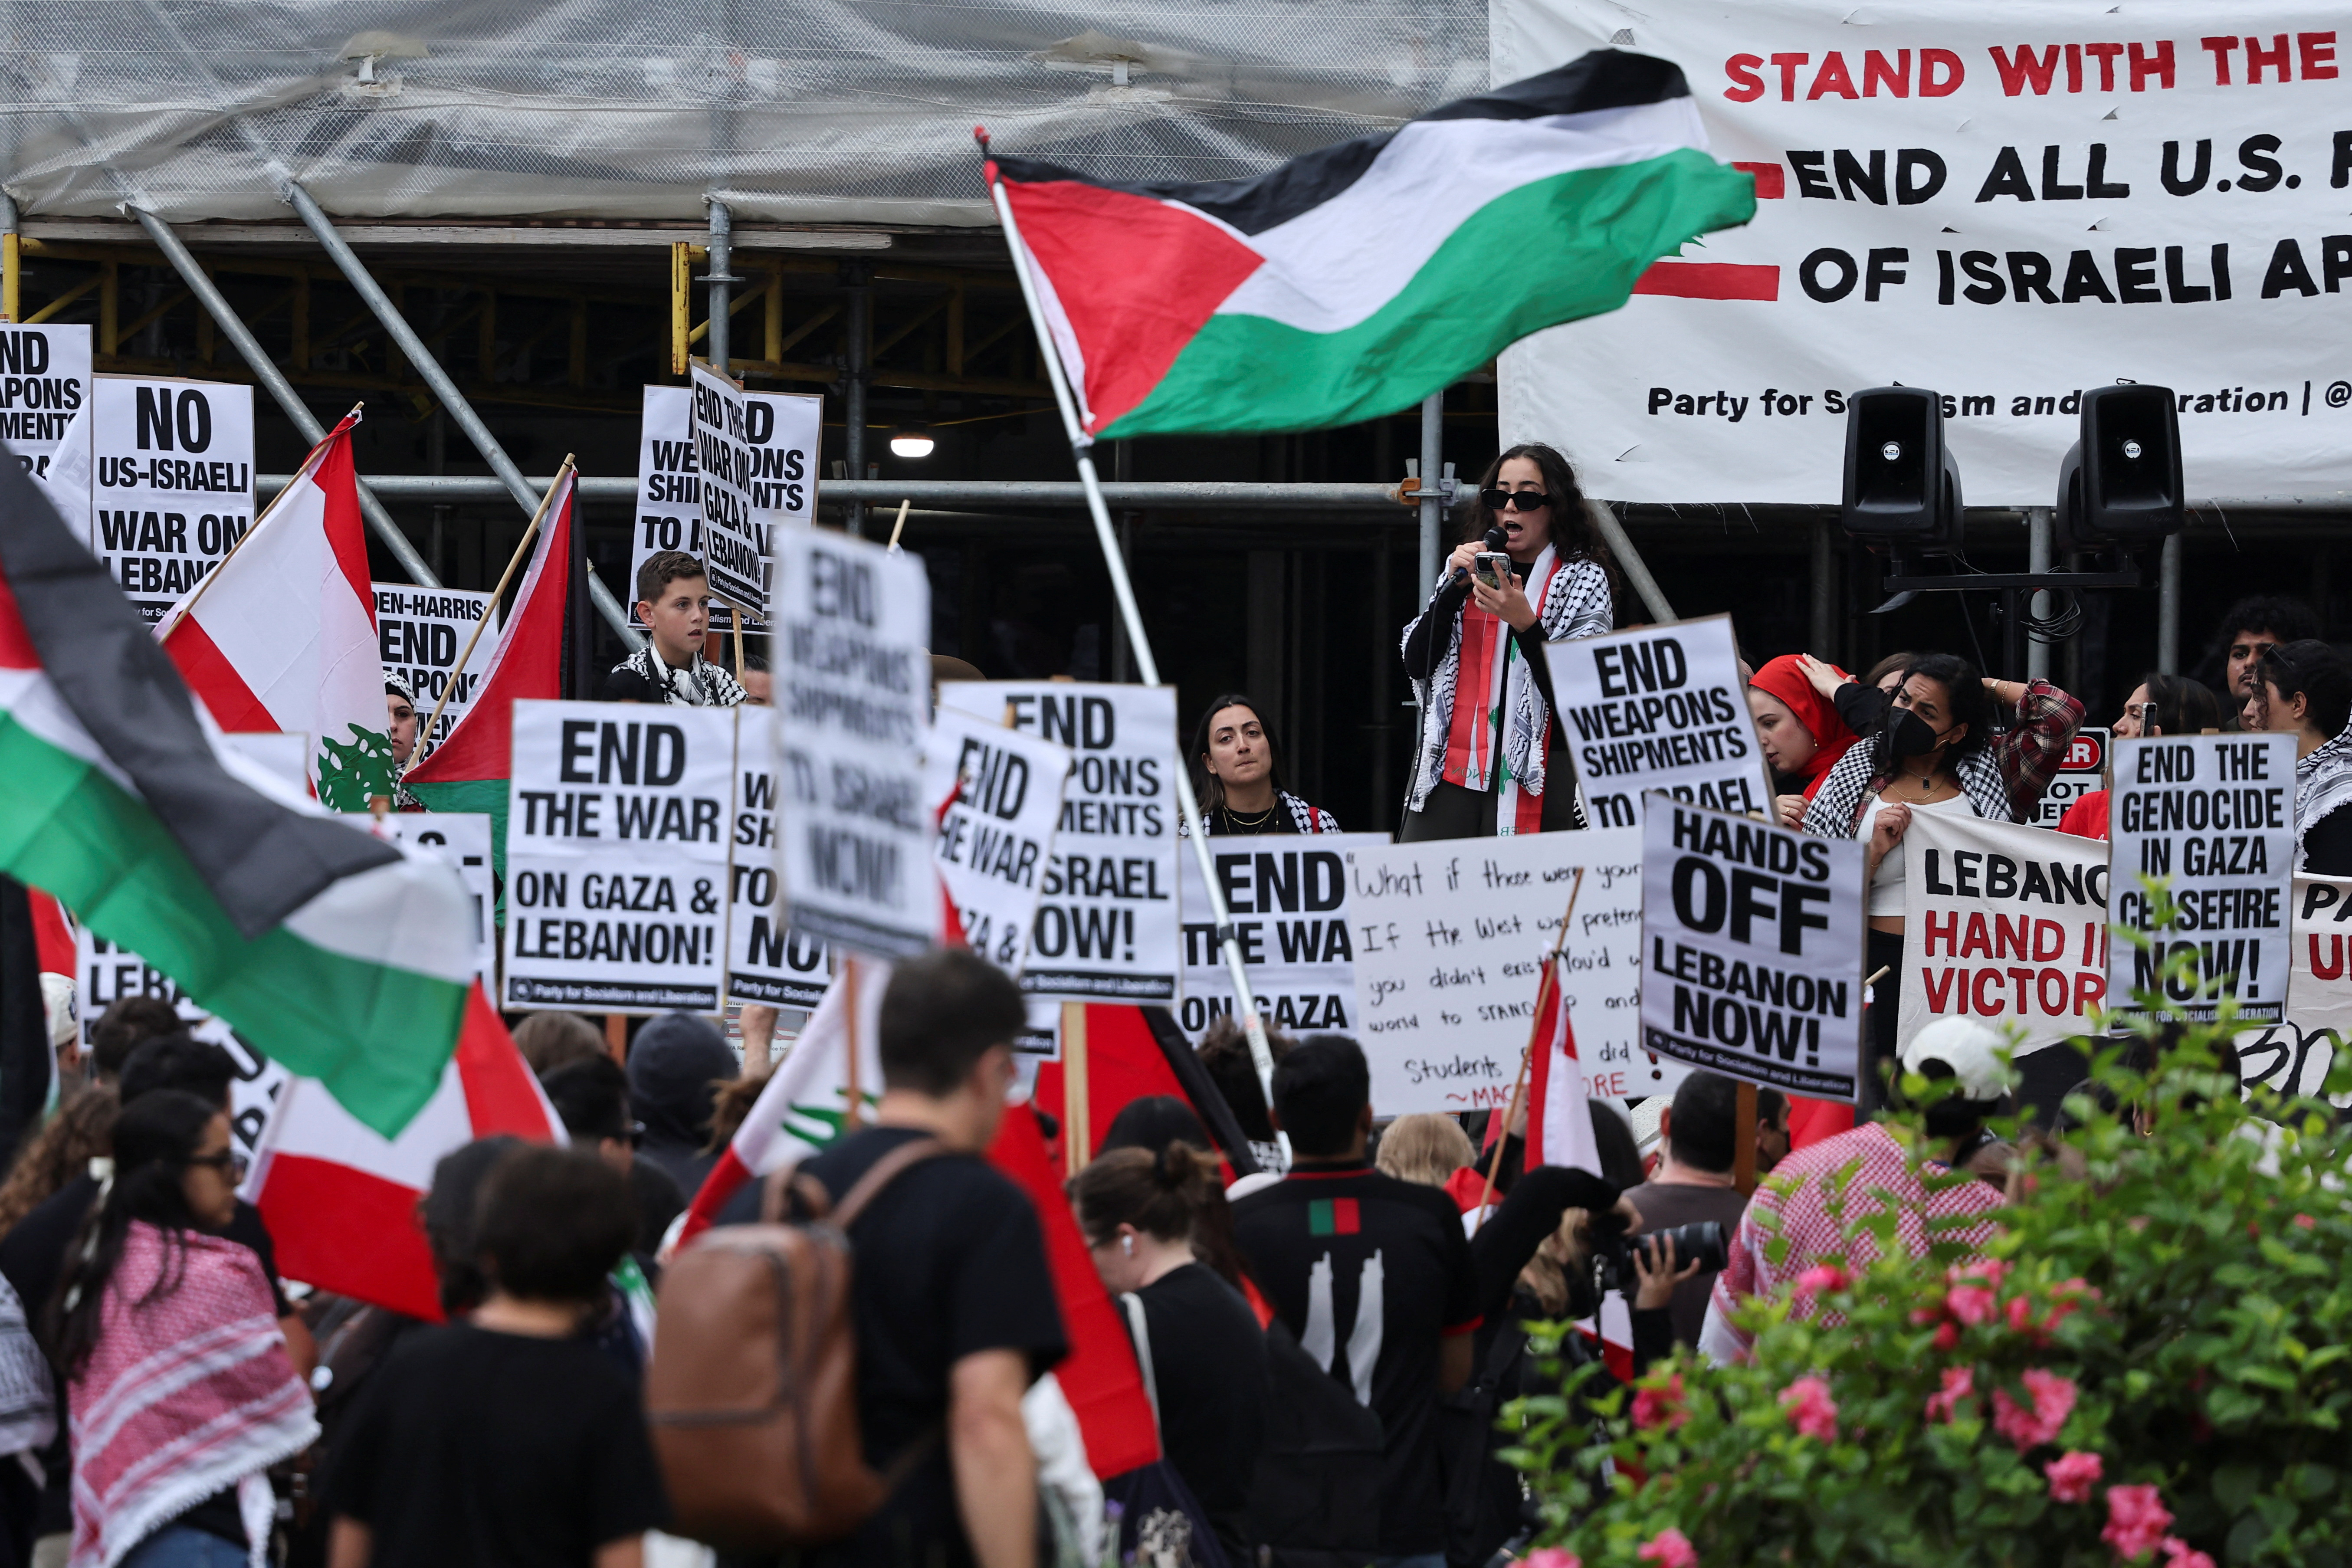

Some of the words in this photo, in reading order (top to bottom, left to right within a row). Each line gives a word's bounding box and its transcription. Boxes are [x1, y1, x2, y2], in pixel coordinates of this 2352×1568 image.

[1723, 48, 1965, 102] STAND
[1988, 40, 2175, 96] WITH
[2200, 31, 2339, 85] THE
[1786, 148, 1947, 205] END
[1975, 143, 2130, 202] ALL
[2160, 133, 2302, 197] U.S.
[1799, 247, 1909, 303] OF
[1937, 243, 2231, 305] ISRAELI
[0, 331, 49, 375] ND
[136, 386, 212, 453] NO
[695, 381, 723, 430] END
[724, 396, 748, 446] THE
[1649, 387, 1748, 422] Party
[1760, 389, 1814, 416] for
[2011, 390, 2082, 417] and
[2178, 386, 2288, 413] ration
[99, 457, 248, 493] US-ISRAELI
[652, 440, 804, 481] WEONS
[698, 428, 733, 484] WAR
[734, 447, 751, 496] ON
[648, 474, 803, 511] SHINTS
[704, 481, 740, 532] GAZA
[742, 501, 751, 541] &
[99, 510, 187, 554] WAR
[197, 513, 246, 555] ON
[641, 516, 681, 550] TO
[706, 527, 761, 586] LEBANON!
[142, 607, 154, 616] for
[729, 582, 744, 596] Socialism
[709, 614, 731, 623] alism
[740, 617, 750, 625] nd
[379, 619, 457, 667] END
[1593, 637, 1687, 697] END
[1005, 695, 1114, 750] END
[1569, 686, 1735, 741] WEAPONS
[560, 718, 686, 787] END
[1583, 727, 1748, 777] SHIPMENTS
[2137, 745, 2194, 784] END
[2215, 743, 2270, 780] THE
[519, 791, 601, 838] THE
[617, 794, 720, 844] WAR
[1591, 793, 1635, 827] TO
[2121, 788, 2283, 833] GENOCIDE
[970, 823, 1037, 889] WAR
[1673, 807, 1830, 882] HANDS
[2141, 837, 2170, 876] IN
[2183, 836, 2267, 875] GAZA
[516, 872, 567, 908] ON
[582, 874, 676, 913] GAZA
[690, 878, 718, 915] &
[1043, 855, 1168, 899] SRAEL
[1216, 852, 1345, 913] END
[1447, 858, 1459, 891] if
[1483, 859, 1532, 889] those
[1543, 866, 1581, 884] wer
[1671, 856, 1831, 956] OFF
[2120, 888, 2280, 932] CEASEFIRE
[515, 918, 714, 965] LEBANON!
[999, 923, 1017, 963] &
[1034, 906, 1134, 961] OW!
[1182, 922, 1265, 966] THE
[1276, 919, 1354, 963] WA
[1361, 923, 1399, 951] If
[1475, 915, 1522, 941] West
[1925, 909, 2065, 963] HAND
[733, 979, 764, 997] Party
[782, 986, 823, 1002] Sociali
[1370, 978, 1406, 1006] you
[1429, 965, 1486, 988] didn't
[1653, 935, 1847, 1018] LEBANON
[2133, 938, 2260, 1001] NOW!
[534, 984, 563, 1001] Party
[566, 985, 582, 999] for
[584, 986, 633, 1002] Socialism
[1369, 1012, 1419, 1033] world
[1441, 1010, 1462, 1026] to
[1478, 1000, 1536, 1021] STAND
[1605, 989, 1641, 1009] and
[2233, 1007, 2279, 1020] IBERATION
[1674, 984, 1820, 1067] NOW!
[1404, 1055, 1503, 1084] Students
[1600, 1040, 1629, 1063] did
[1669, 1040, 1696, 1059] Party
[1698, 1049, 1714, 1062] for
